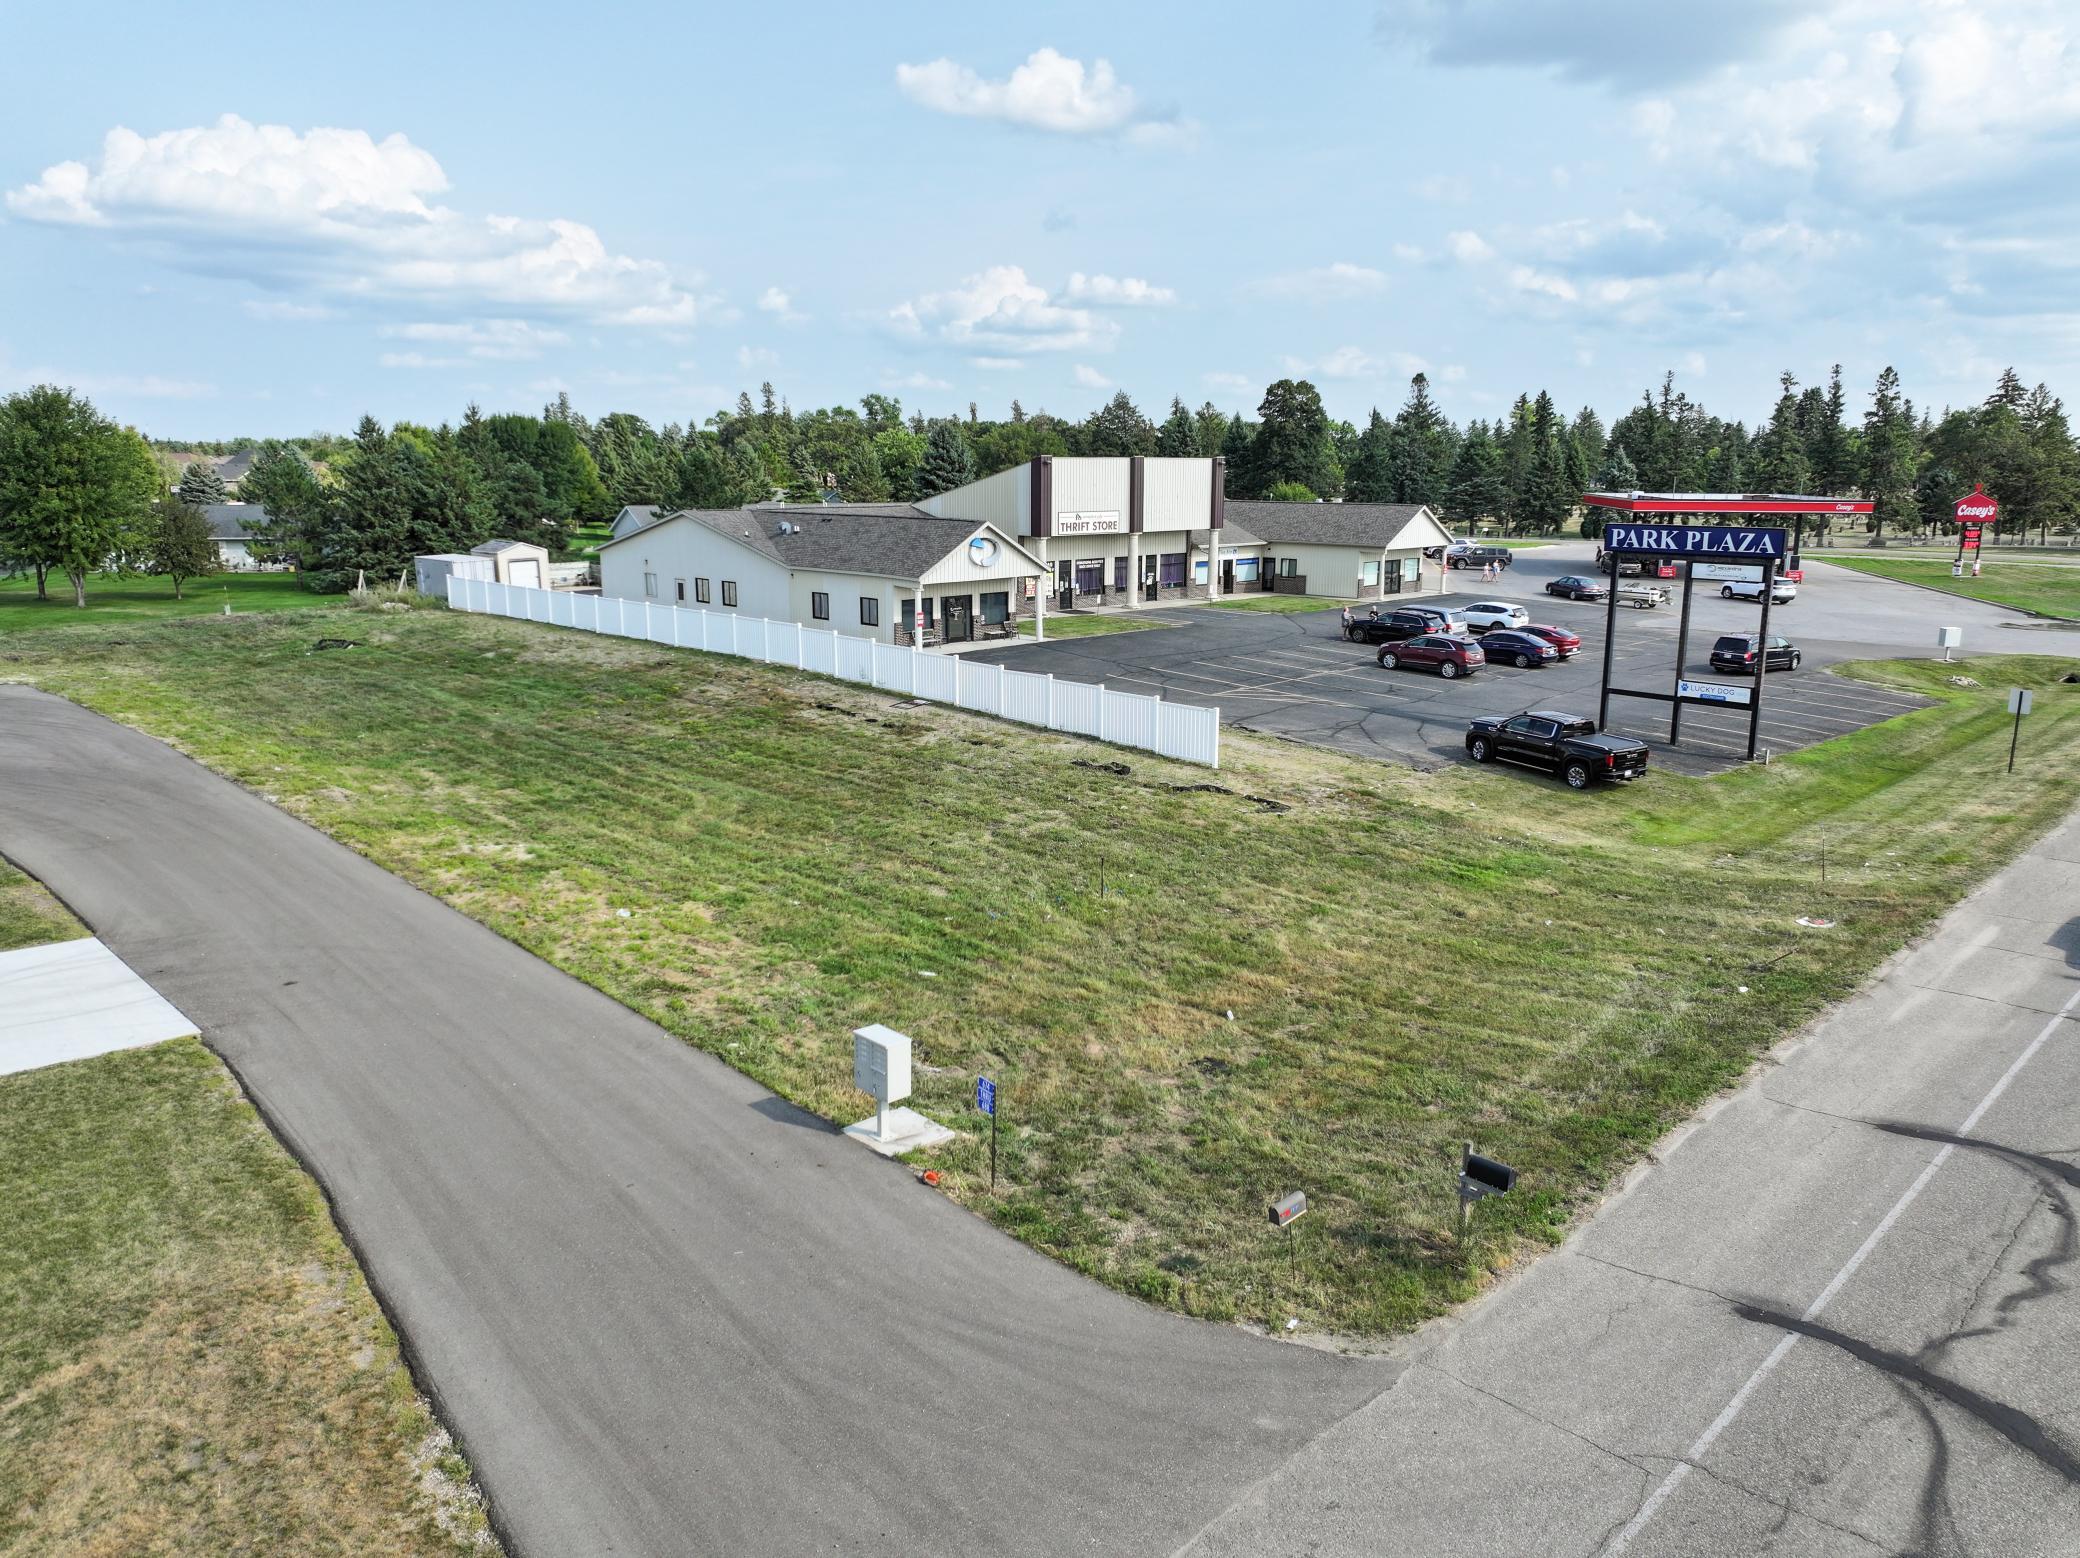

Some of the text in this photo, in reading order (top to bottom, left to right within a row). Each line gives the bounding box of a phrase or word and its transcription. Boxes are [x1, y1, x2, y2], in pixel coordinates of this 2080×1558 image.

[1957, 504, 1995, 518] Casey's
[1060, 521, 1118, 532] THRIFT STORE
[1610, 528, 1775, 554] PARK PLAZA
[1690, 684, 1735, 696] LUCKY DOG
